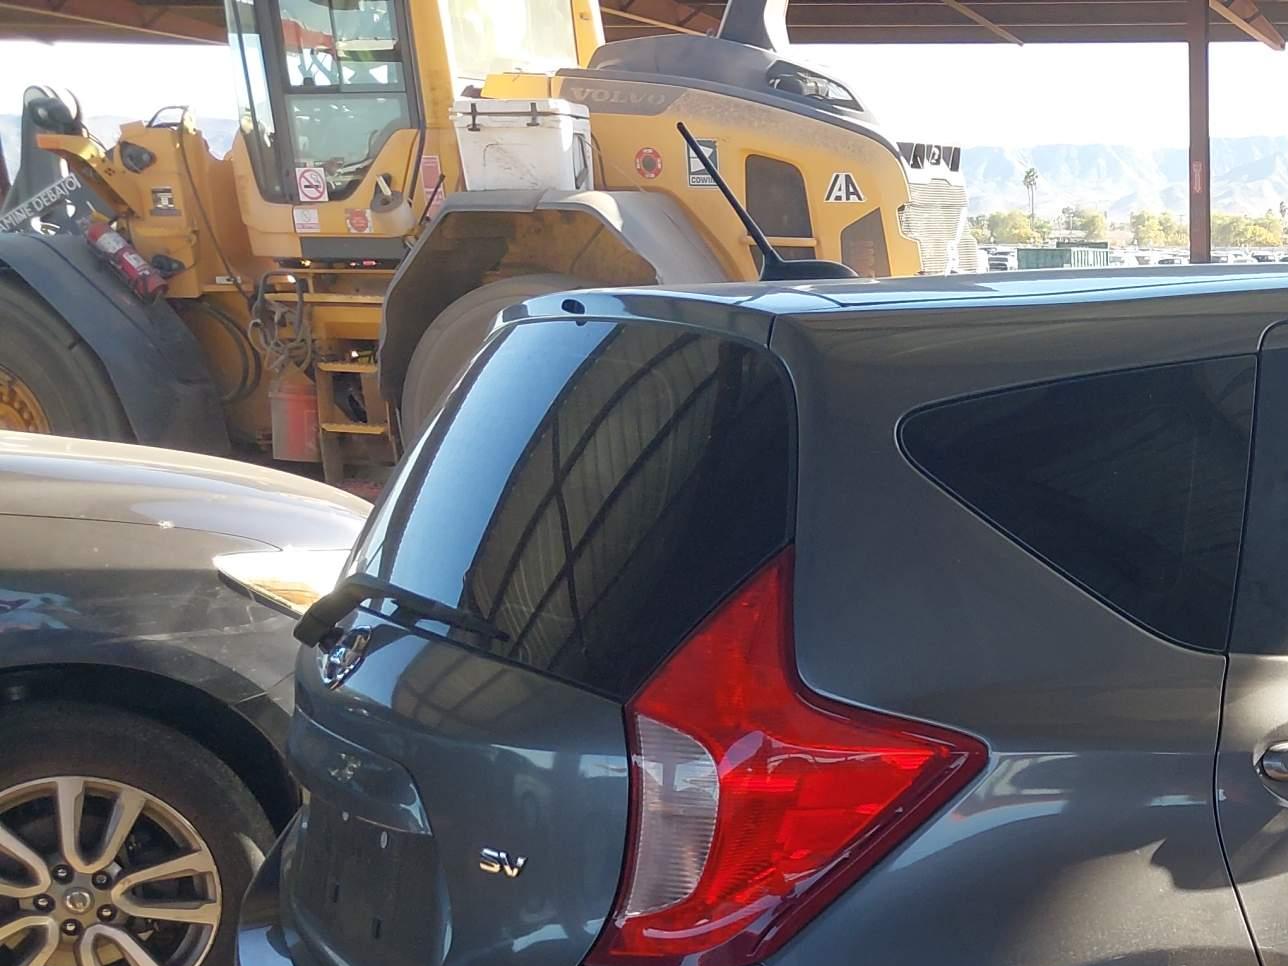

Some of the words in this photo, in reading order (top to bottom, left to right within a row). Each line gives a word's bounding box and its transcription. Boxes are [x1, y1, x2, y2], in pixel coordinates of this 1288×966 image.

[570, 87, 665, 105] VOLVO
[32, 176, 77, 213] DEBAJO
[479, 848, 527, 878] SV
